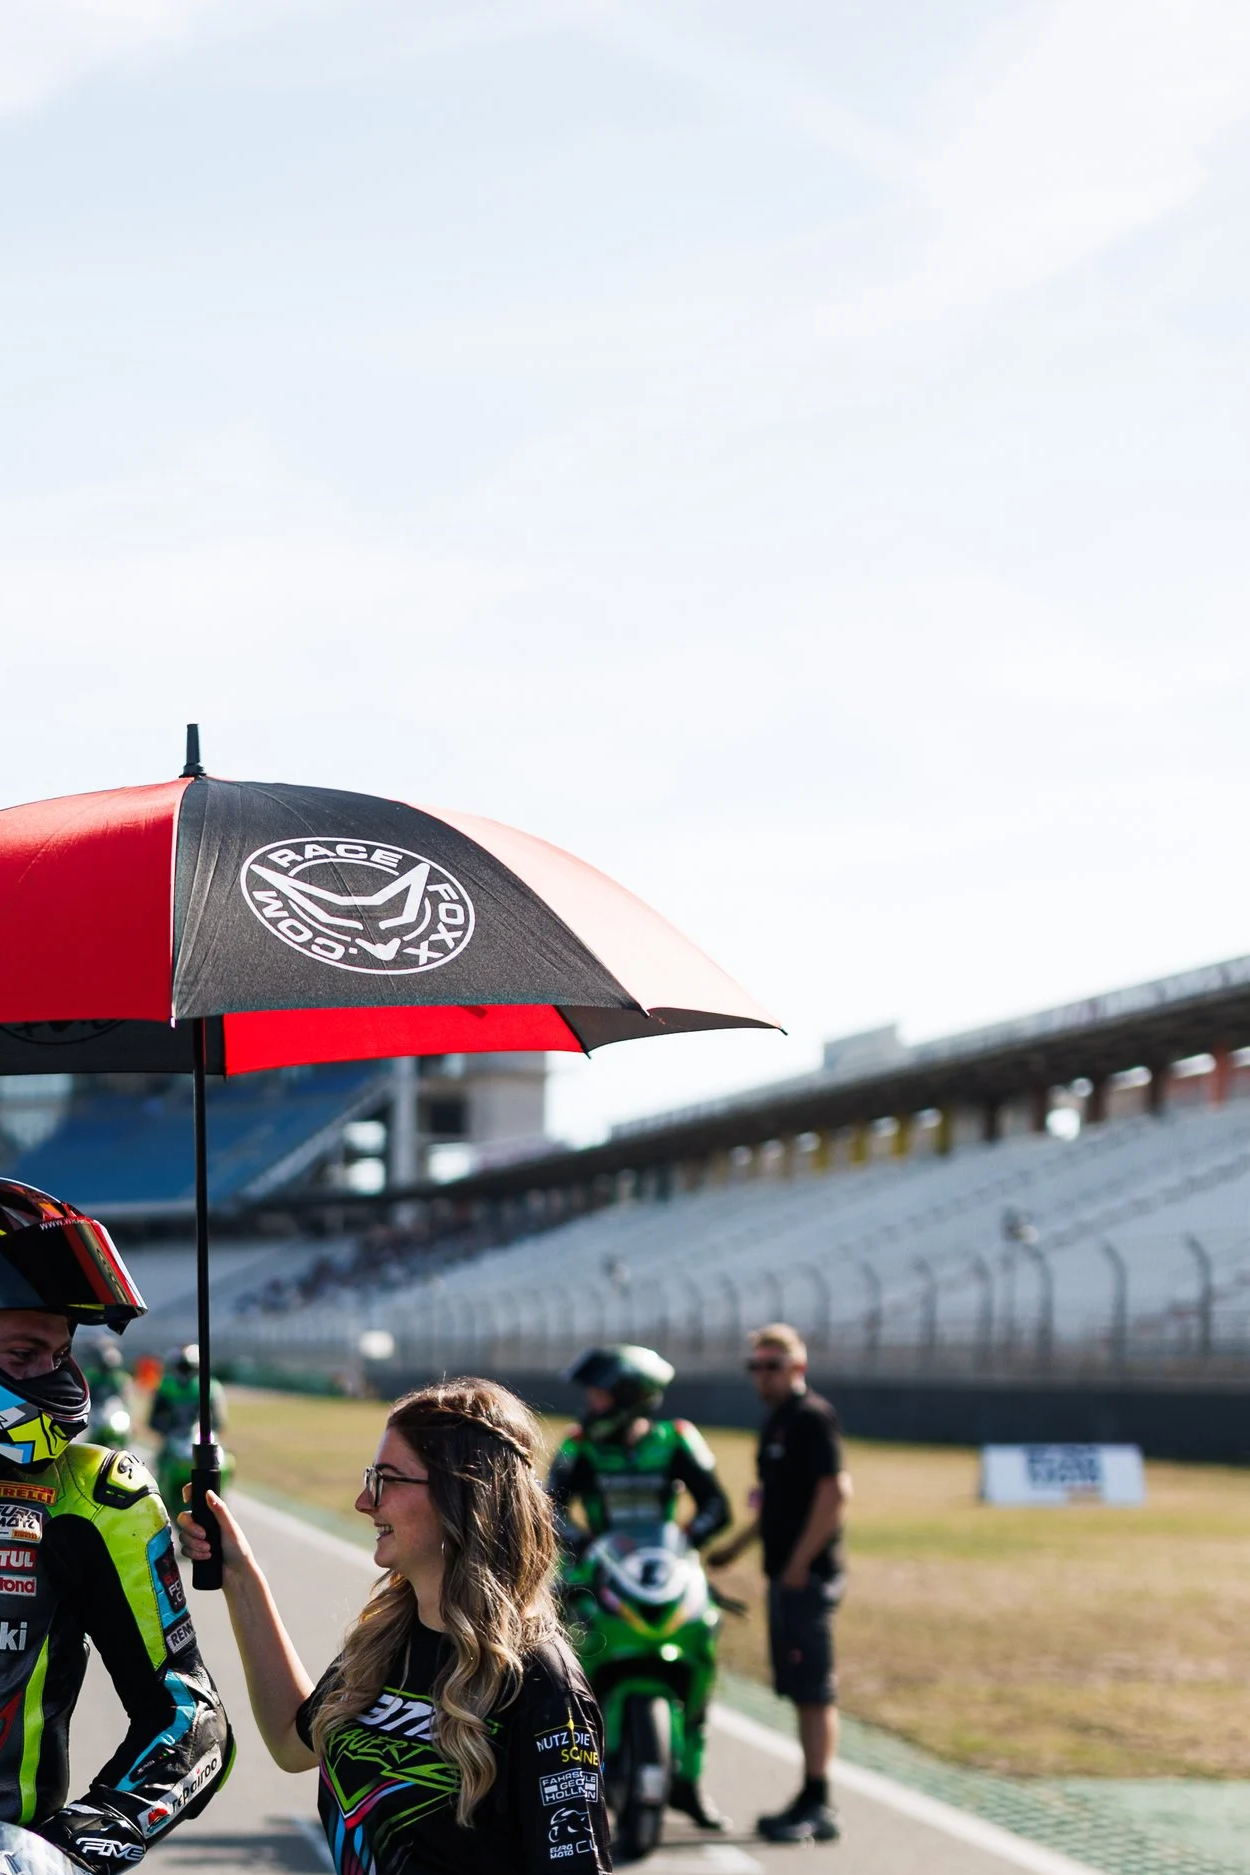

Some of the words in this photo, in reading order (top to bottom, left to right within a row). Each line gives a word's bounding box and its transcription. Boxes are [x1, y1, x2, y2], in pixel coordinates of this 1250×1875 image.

[267, 843, 403, 868] RACE
[536, 1731, 569, 1753] NUTZ
[75, 1837, 146, 1861] FIVE
